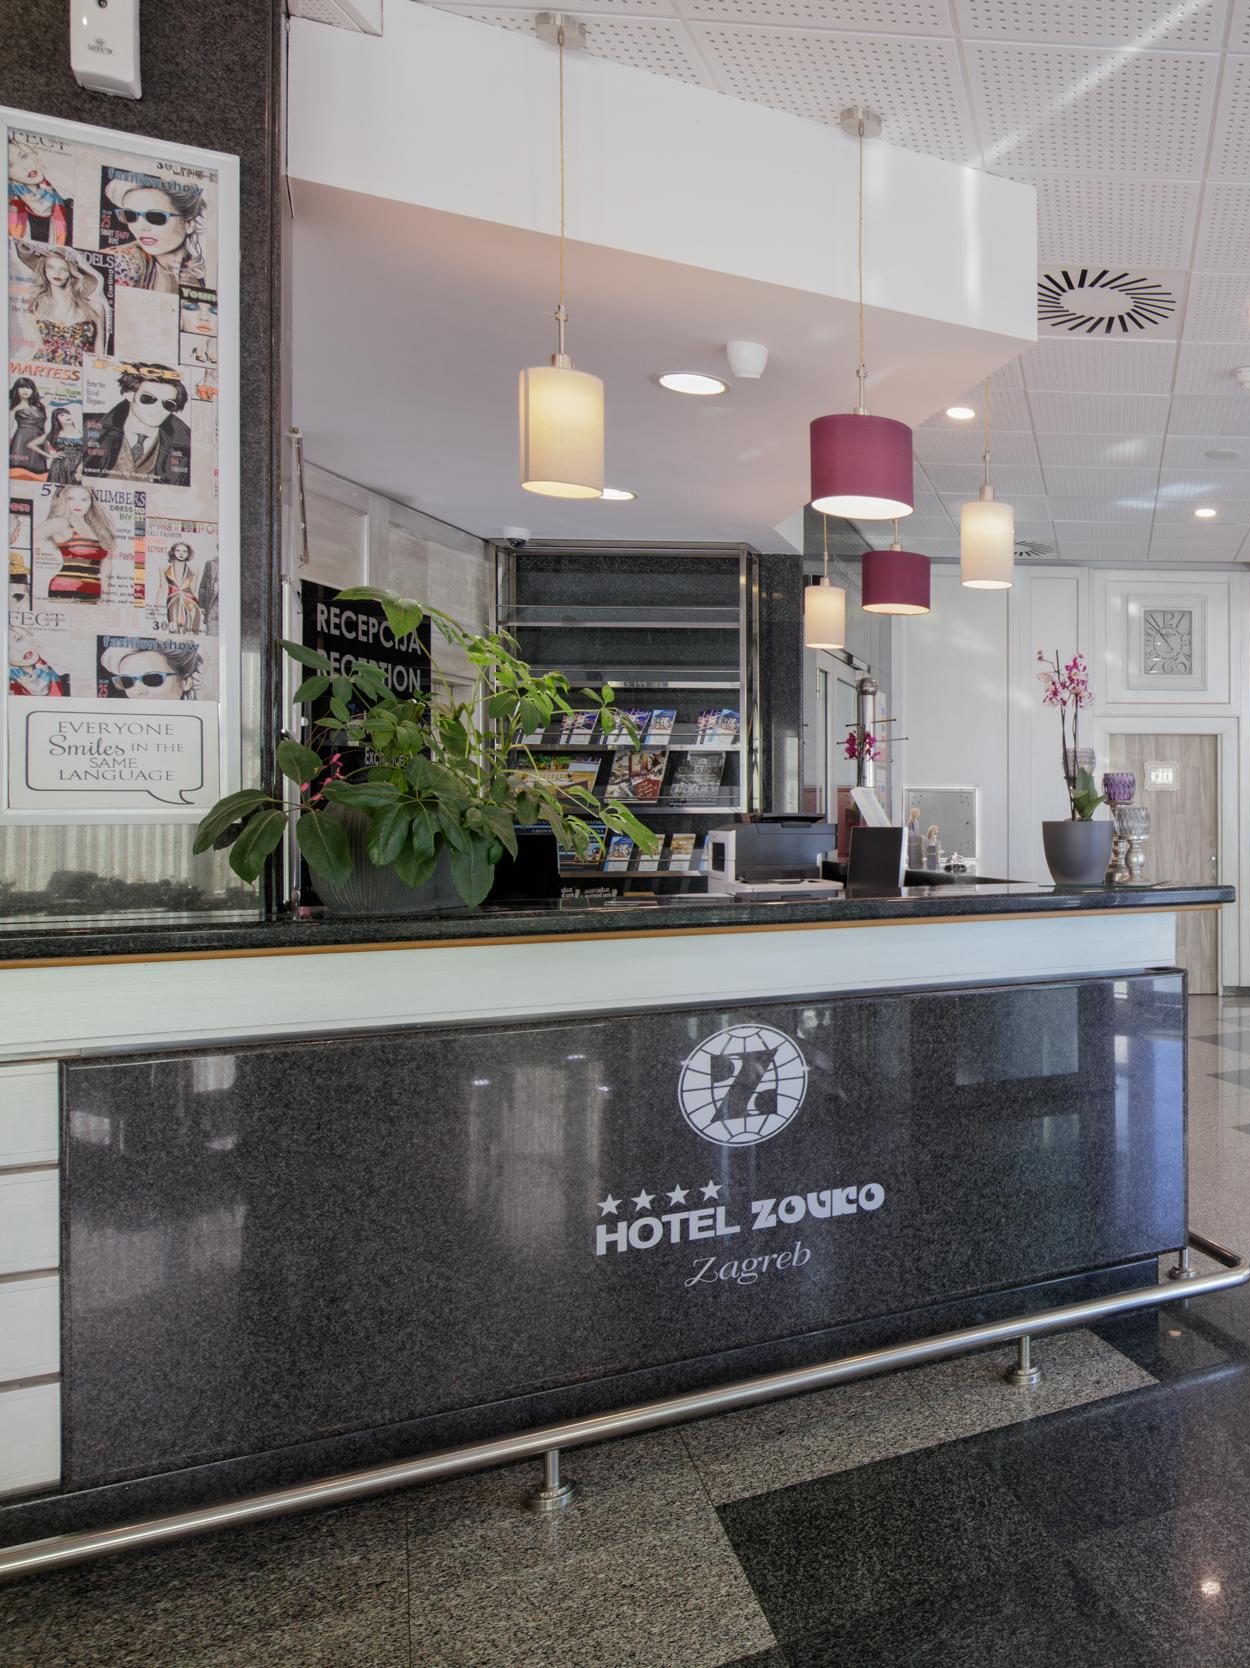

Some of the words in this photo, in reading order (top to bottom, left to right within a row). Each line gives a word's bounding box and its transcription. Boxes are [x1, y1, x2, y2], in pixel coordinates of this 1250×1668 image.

[91, 489, 146, 508] NUMBERS
[109, 504, 133, 512] DRESS
[161, 640, 199, 652] show
[98, 684, 109, 698] 25
[58, 721, 175, 736] EVERYONE
[49, 734, 126, 757] Smiles
[131, 743, 148, 752] IN
[153, 743, 184, 753] THE
[89, 757, 138, 769] SAME
[59, 769, 176, 781] LANGUAGE
[596, 1206, 741, 1256] HOTEL
[684, 1241, 812, 1287] Zagreb
